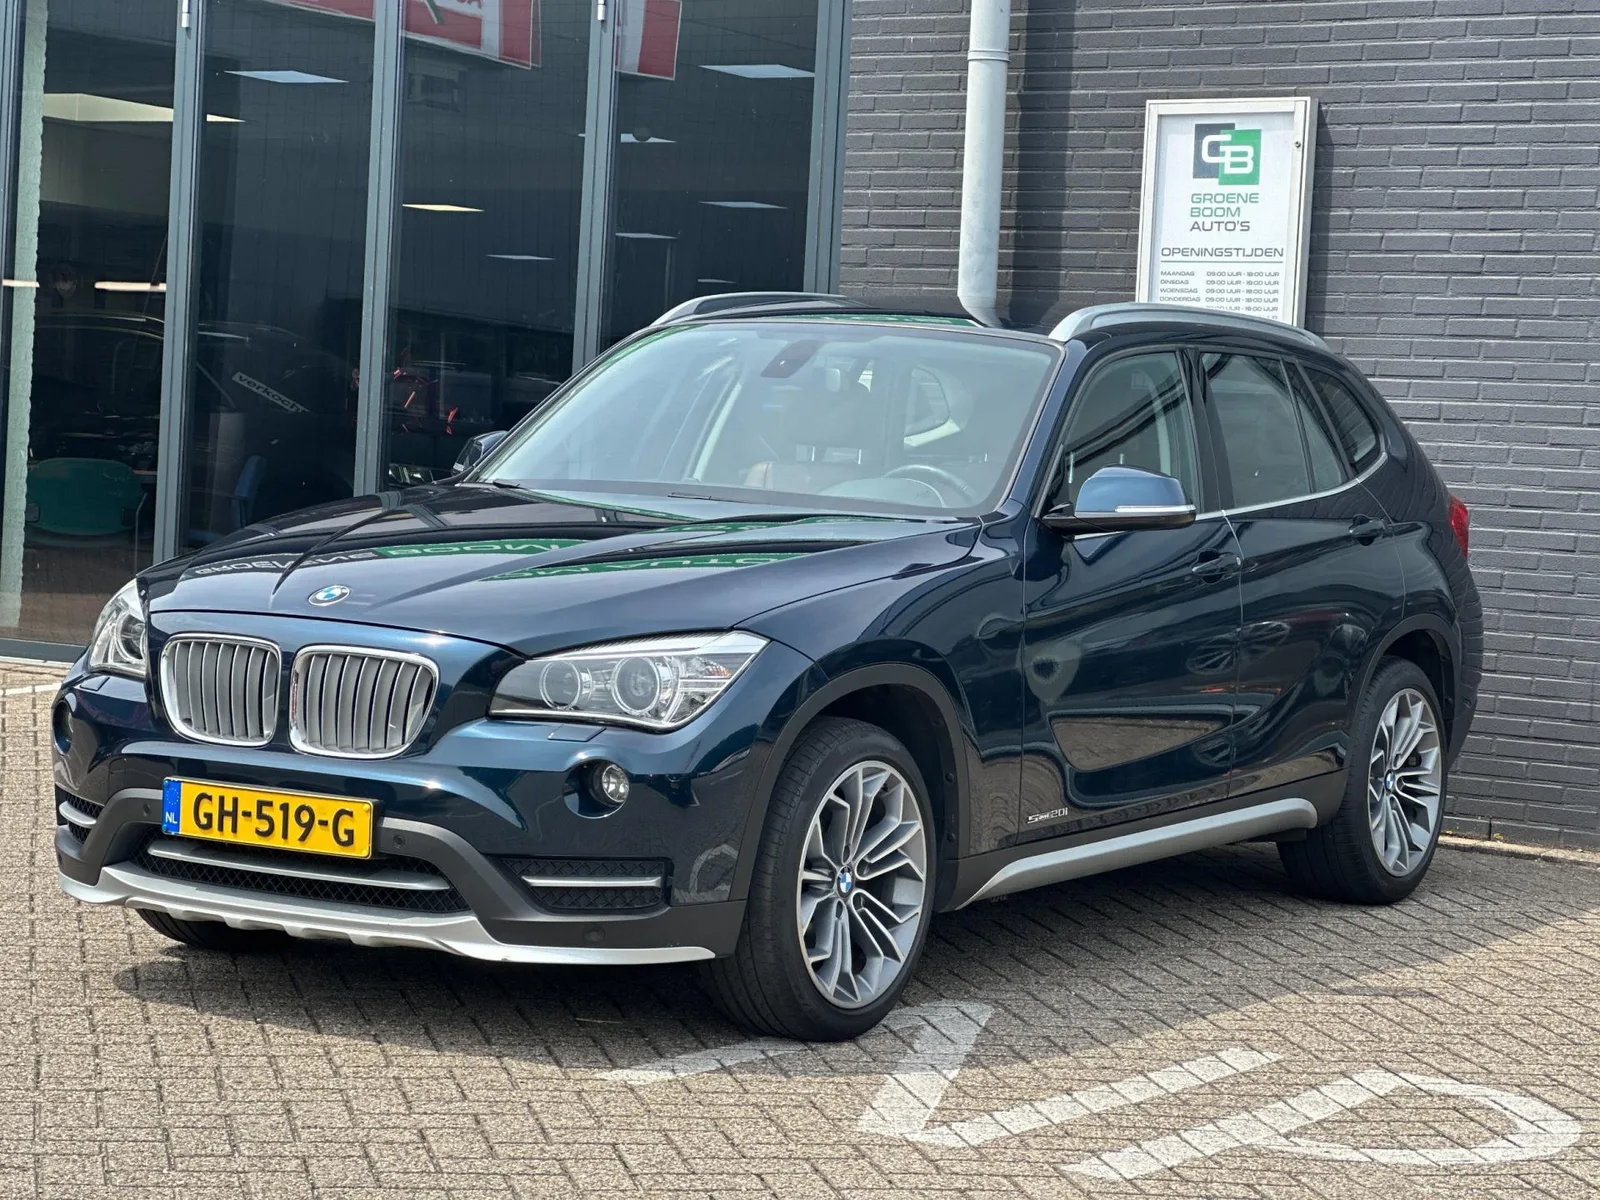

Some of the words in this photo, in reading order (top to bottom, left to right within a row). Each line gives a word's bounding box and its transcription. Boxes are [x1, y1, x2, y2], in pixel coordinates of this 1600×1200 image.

[1191, 192, 1260, 204] GROENE
[1190, 206, 1241, 218] BOOM
[1189, 220, 1251, 232] AUTO'S
[1161, 247, 1284, 258] OPENINGSTIJDEN
[165, 811, 178, 825] NL
[193, 791, 355, 848] GH-519-G
